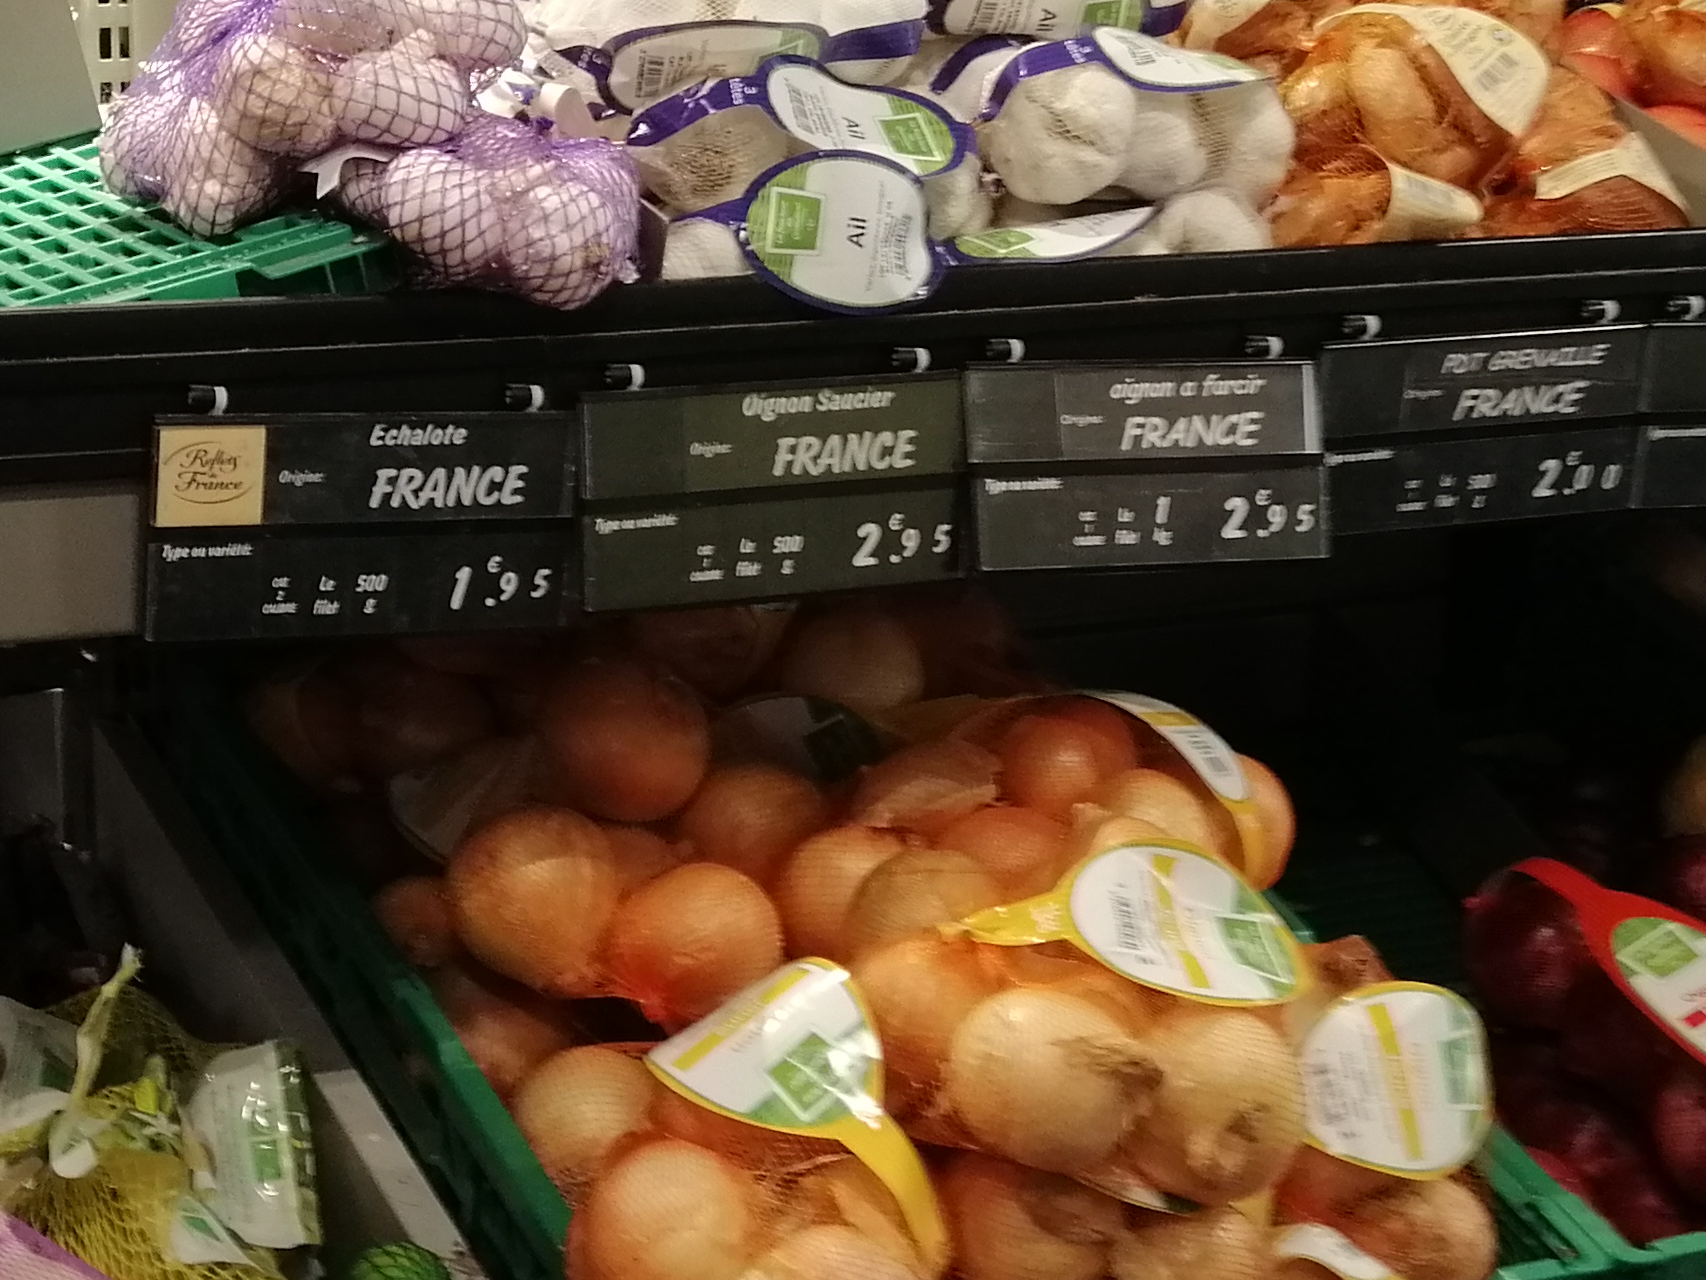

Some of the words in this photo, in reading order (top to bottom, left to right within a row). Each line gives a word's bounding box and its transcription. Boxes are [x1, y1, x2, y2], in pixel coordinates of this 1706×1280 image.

[846, 217, 867, 249] Ail
[1451, 379, 1592, 422] FRANCE
[1120, 410, 1267, 452] FRANCE
[772, 429, 920, 477] FRANCE
[174, 471, 244, 492] France
[368, 465, 530, 510] FRANCE
[354, 574, 390, 593] 500
